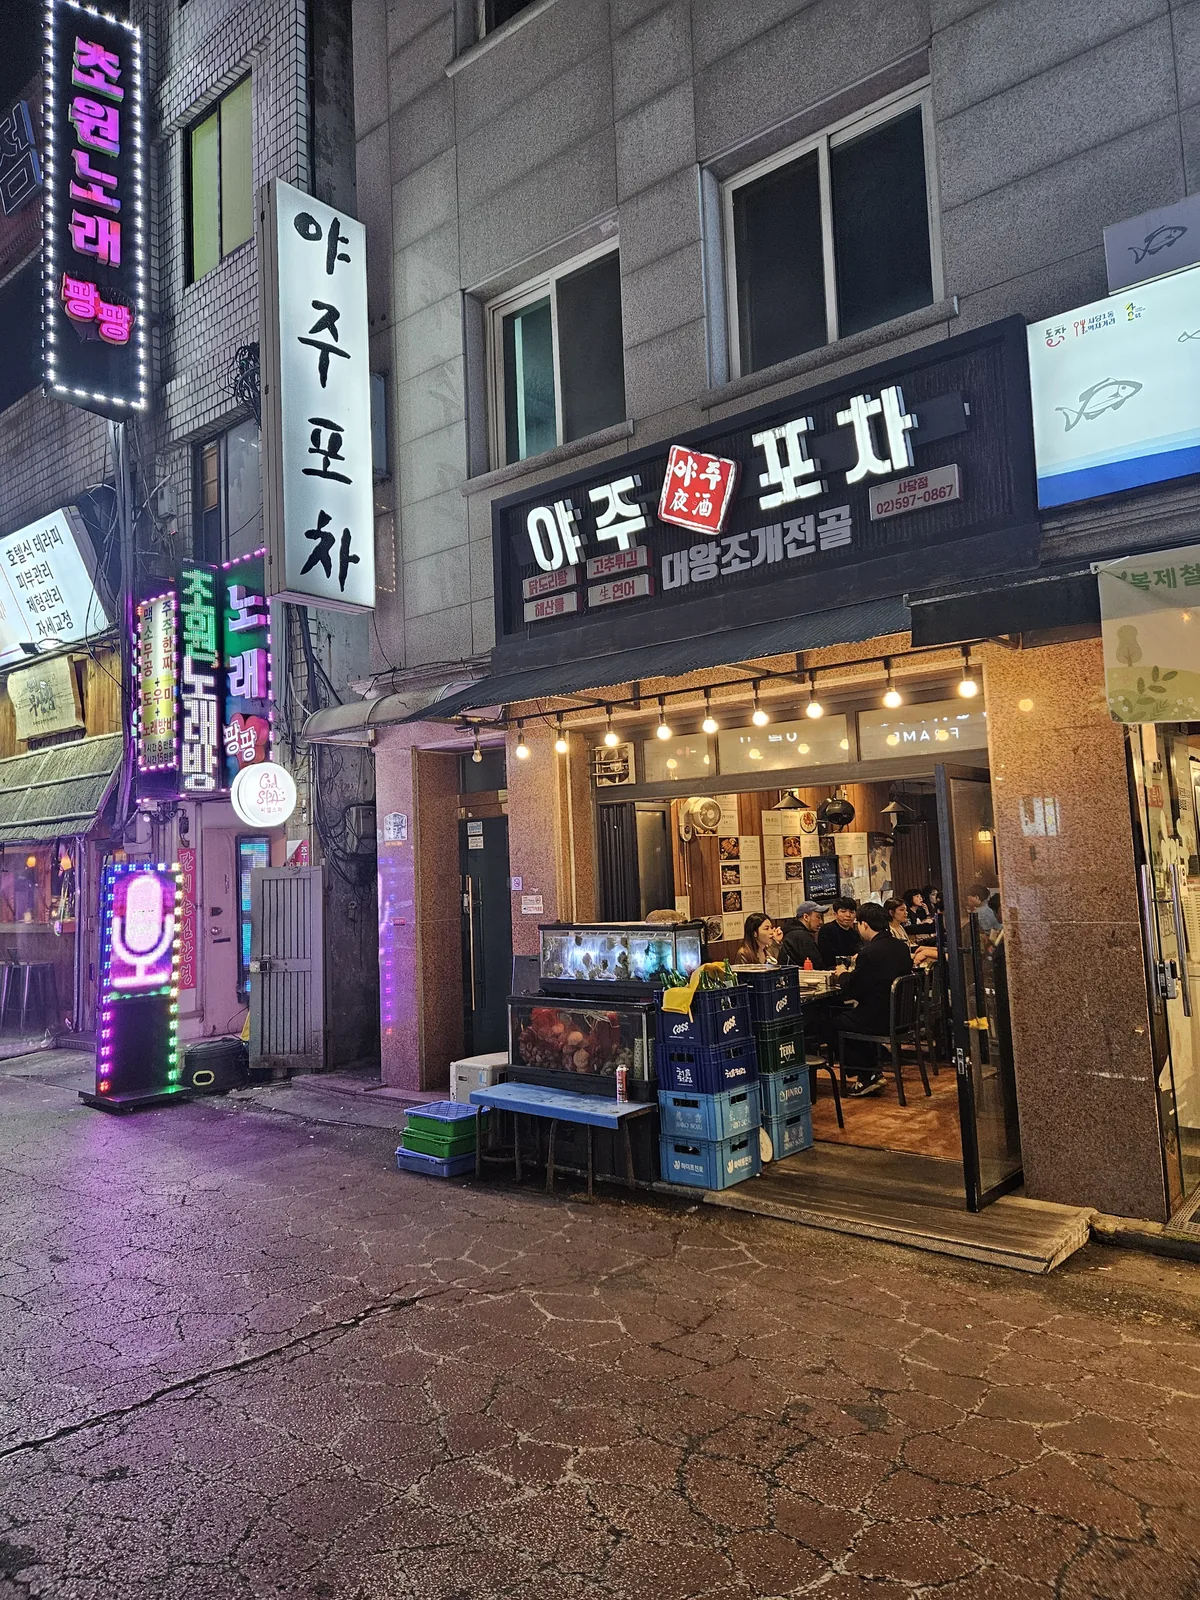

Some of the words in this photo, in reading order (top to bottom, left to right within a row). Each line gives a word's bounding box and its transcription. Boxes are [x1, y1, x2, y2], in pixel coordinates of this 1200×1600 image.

[294, 212, 360, 592] 야주포차
[526, 474, 650, 571] 야주
[752, 385, 918, 511] 포차
[673, 455, 722, 491] 야주
[897, 476, 929, 494] 사당점
[669, 488, 713, 518] 夜酒
[876, 484, 954, 515] 02)597-0867
[6, 539, 36, 567] 호텔식
[32, 525, 64, 553] 테라피
[661, 504, 854, 591] 대왕조개전골
[15, 560, 54, 590] 피부관리
[593, 550, 638, 576] 고추튀김
[528, 568, 568, 596] 닭도리탕
[26, 585, 64, 614] 체형관리
[534, 596, 565, 618] 해산물
[36, 609, 74, 637] 자세교정
[227, 584, 265, 699] 노래
[142, 685, 174, 707] 도우미
